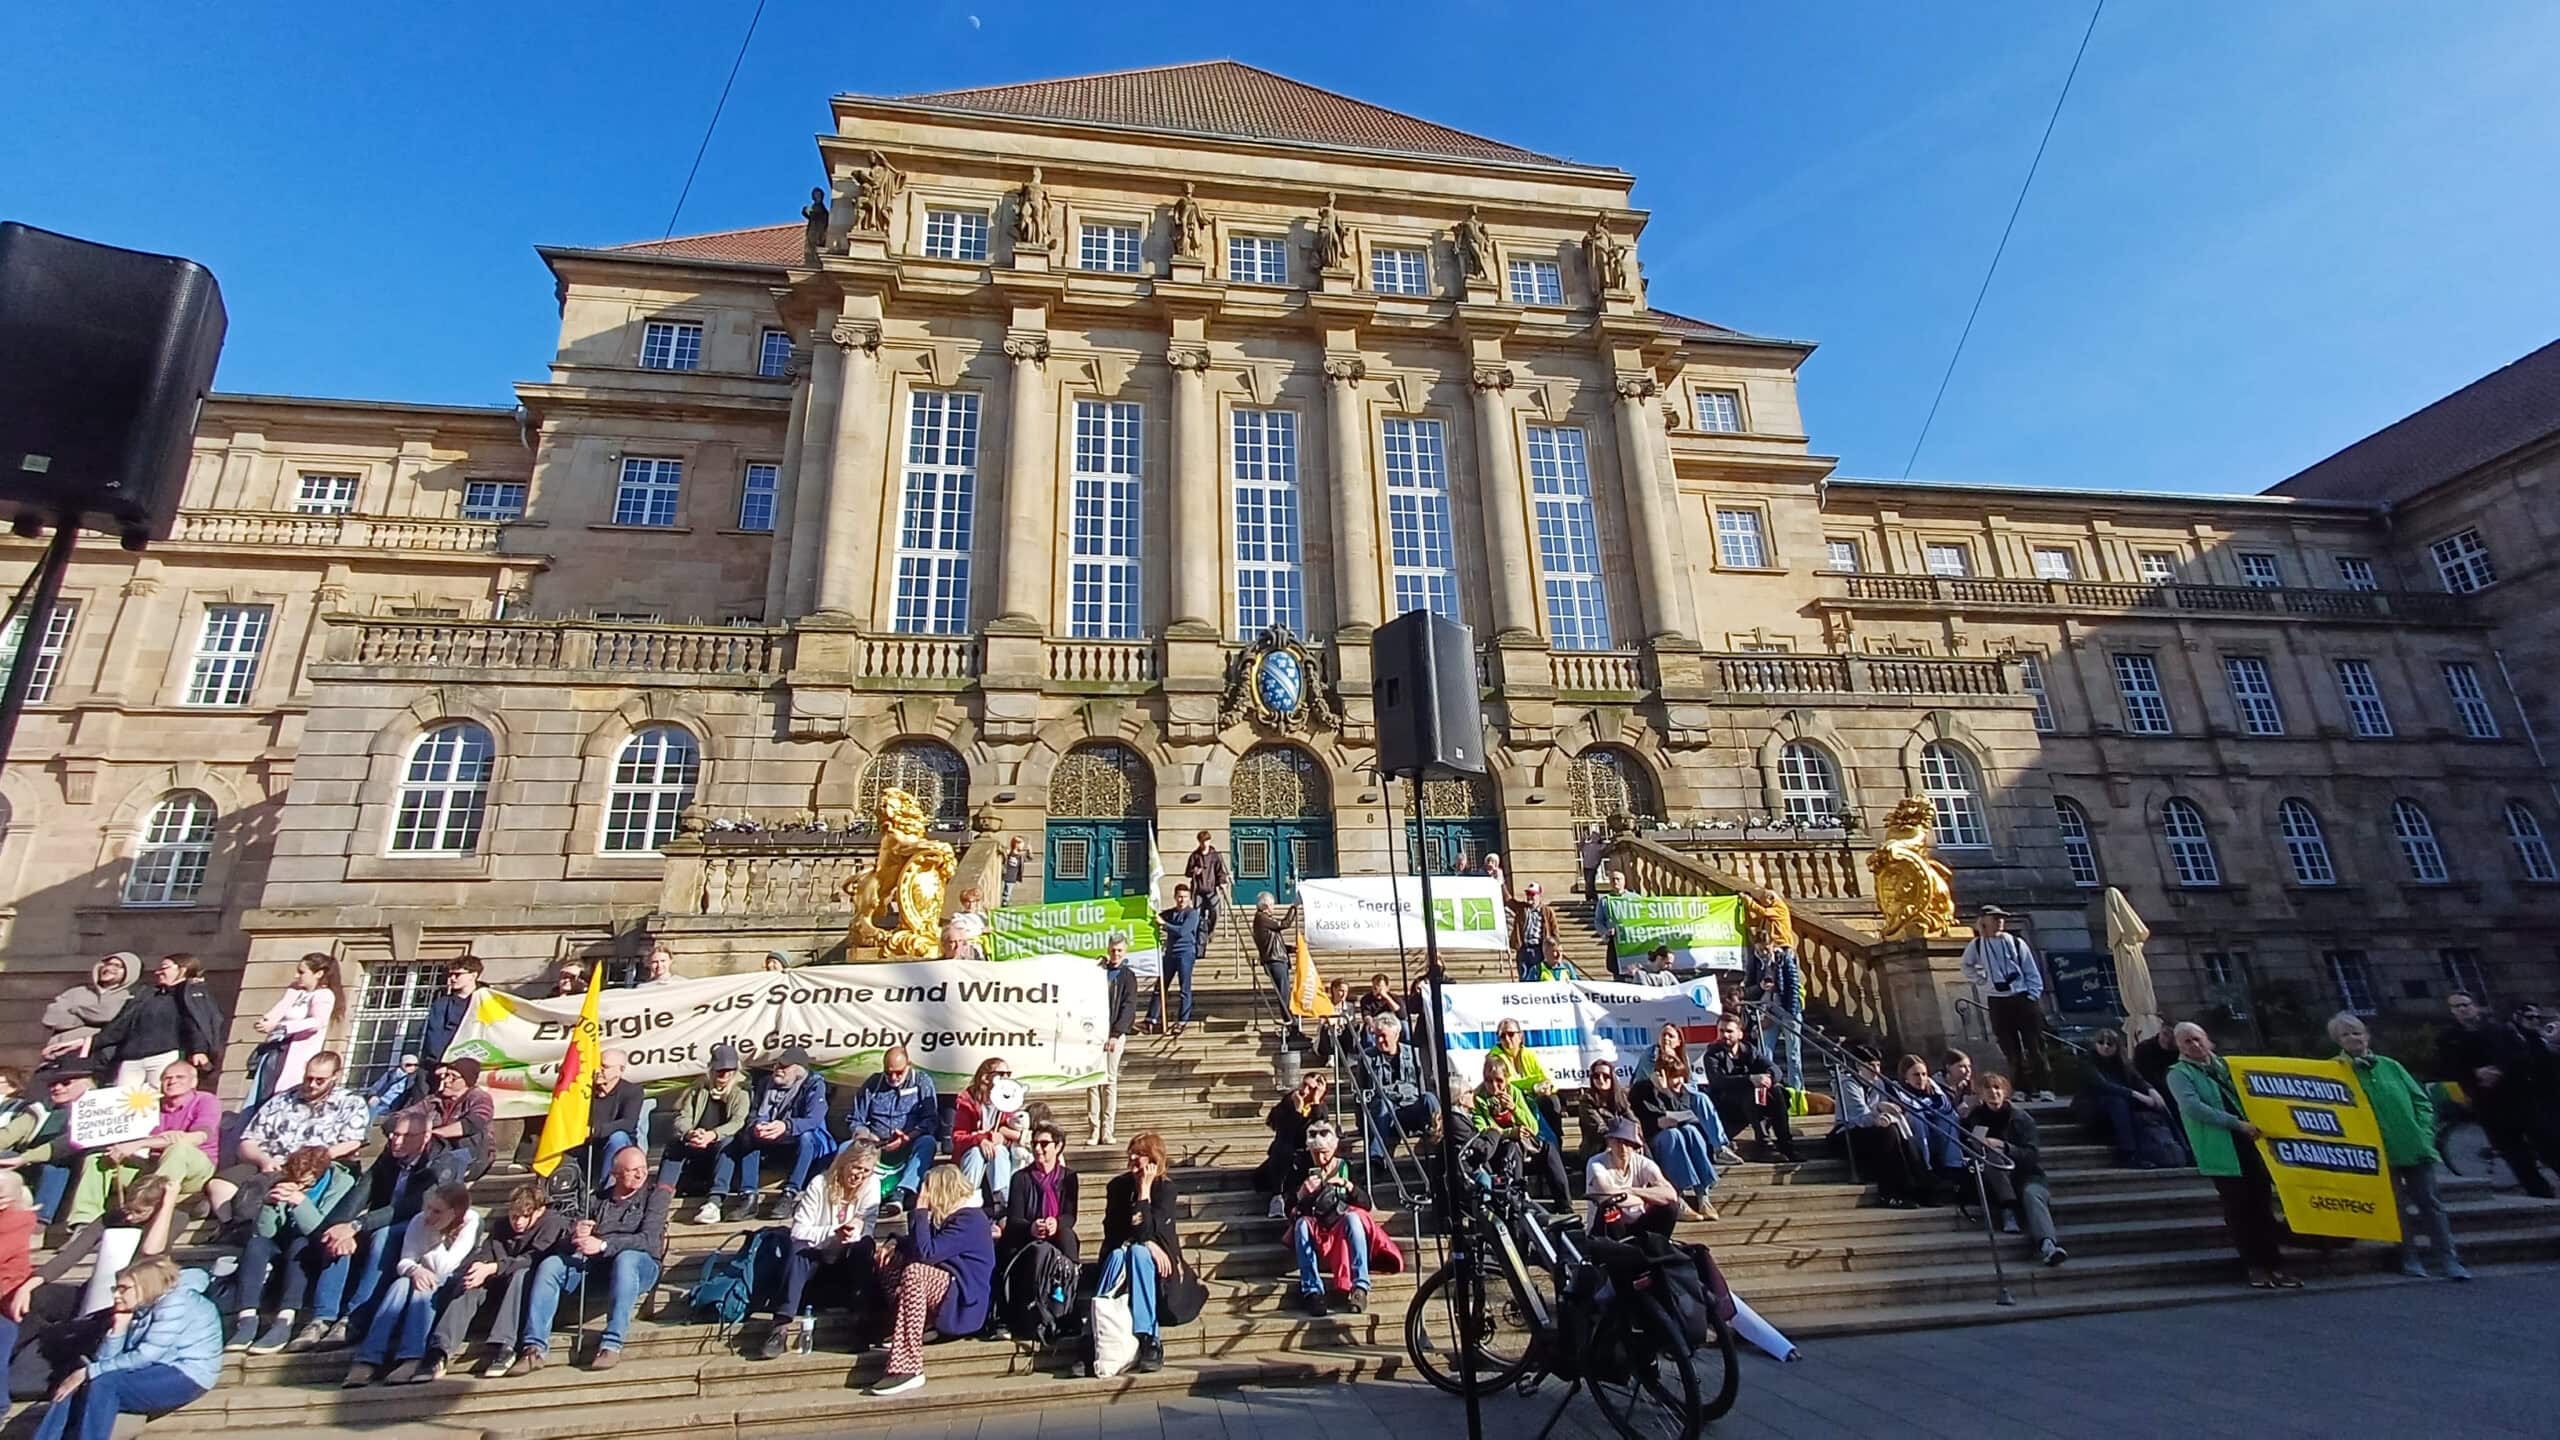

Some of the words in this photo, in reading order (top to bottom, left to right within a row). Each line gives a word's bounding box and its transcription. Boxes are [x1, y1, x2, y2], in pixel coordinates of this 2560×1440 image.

[993, 909, 1026, 932] Wir
[1031, 904, 1070, 929] sind
[1077, 902, 1105, 925] die
[1358, 898, 1412, 916] Energie
[1612, 898, 1642, 919] Wir
[1648, 900, 1682, 919] sind
[1688, 900, 1710, 918] die
[1315, 919, 1350, 931] Kassel
[1616, 920, 1736, 945] Energiewende!
[691, 993, 755, 1017] aus
[766, 984, 873, 1005] Sonne
[884, 982, 948, 1002] und
[958, 981, 1059, 1003] Wind!
[628, 1043, 698, 1066] onst
[709, 1034, 754, 1053] die
[763, 1028, 913, 1052] Gas-Lobby
[920, 1027, 1044, 1051] gewinnt.
[2249, 1074, 2349, 1102] KLIMASCHUTZ
[78, 1098, 96, 1108] DIE
[78, 1106, 113, 1119] SONNE
[77, 1130, 94, 1141] DIE
[99, 1124, 129, 1137] LAGE
[2277, 1141, 2377, 1169] GASAUSSTIEG
[2310, 1194, 2377, 1215] GREENPEACE
